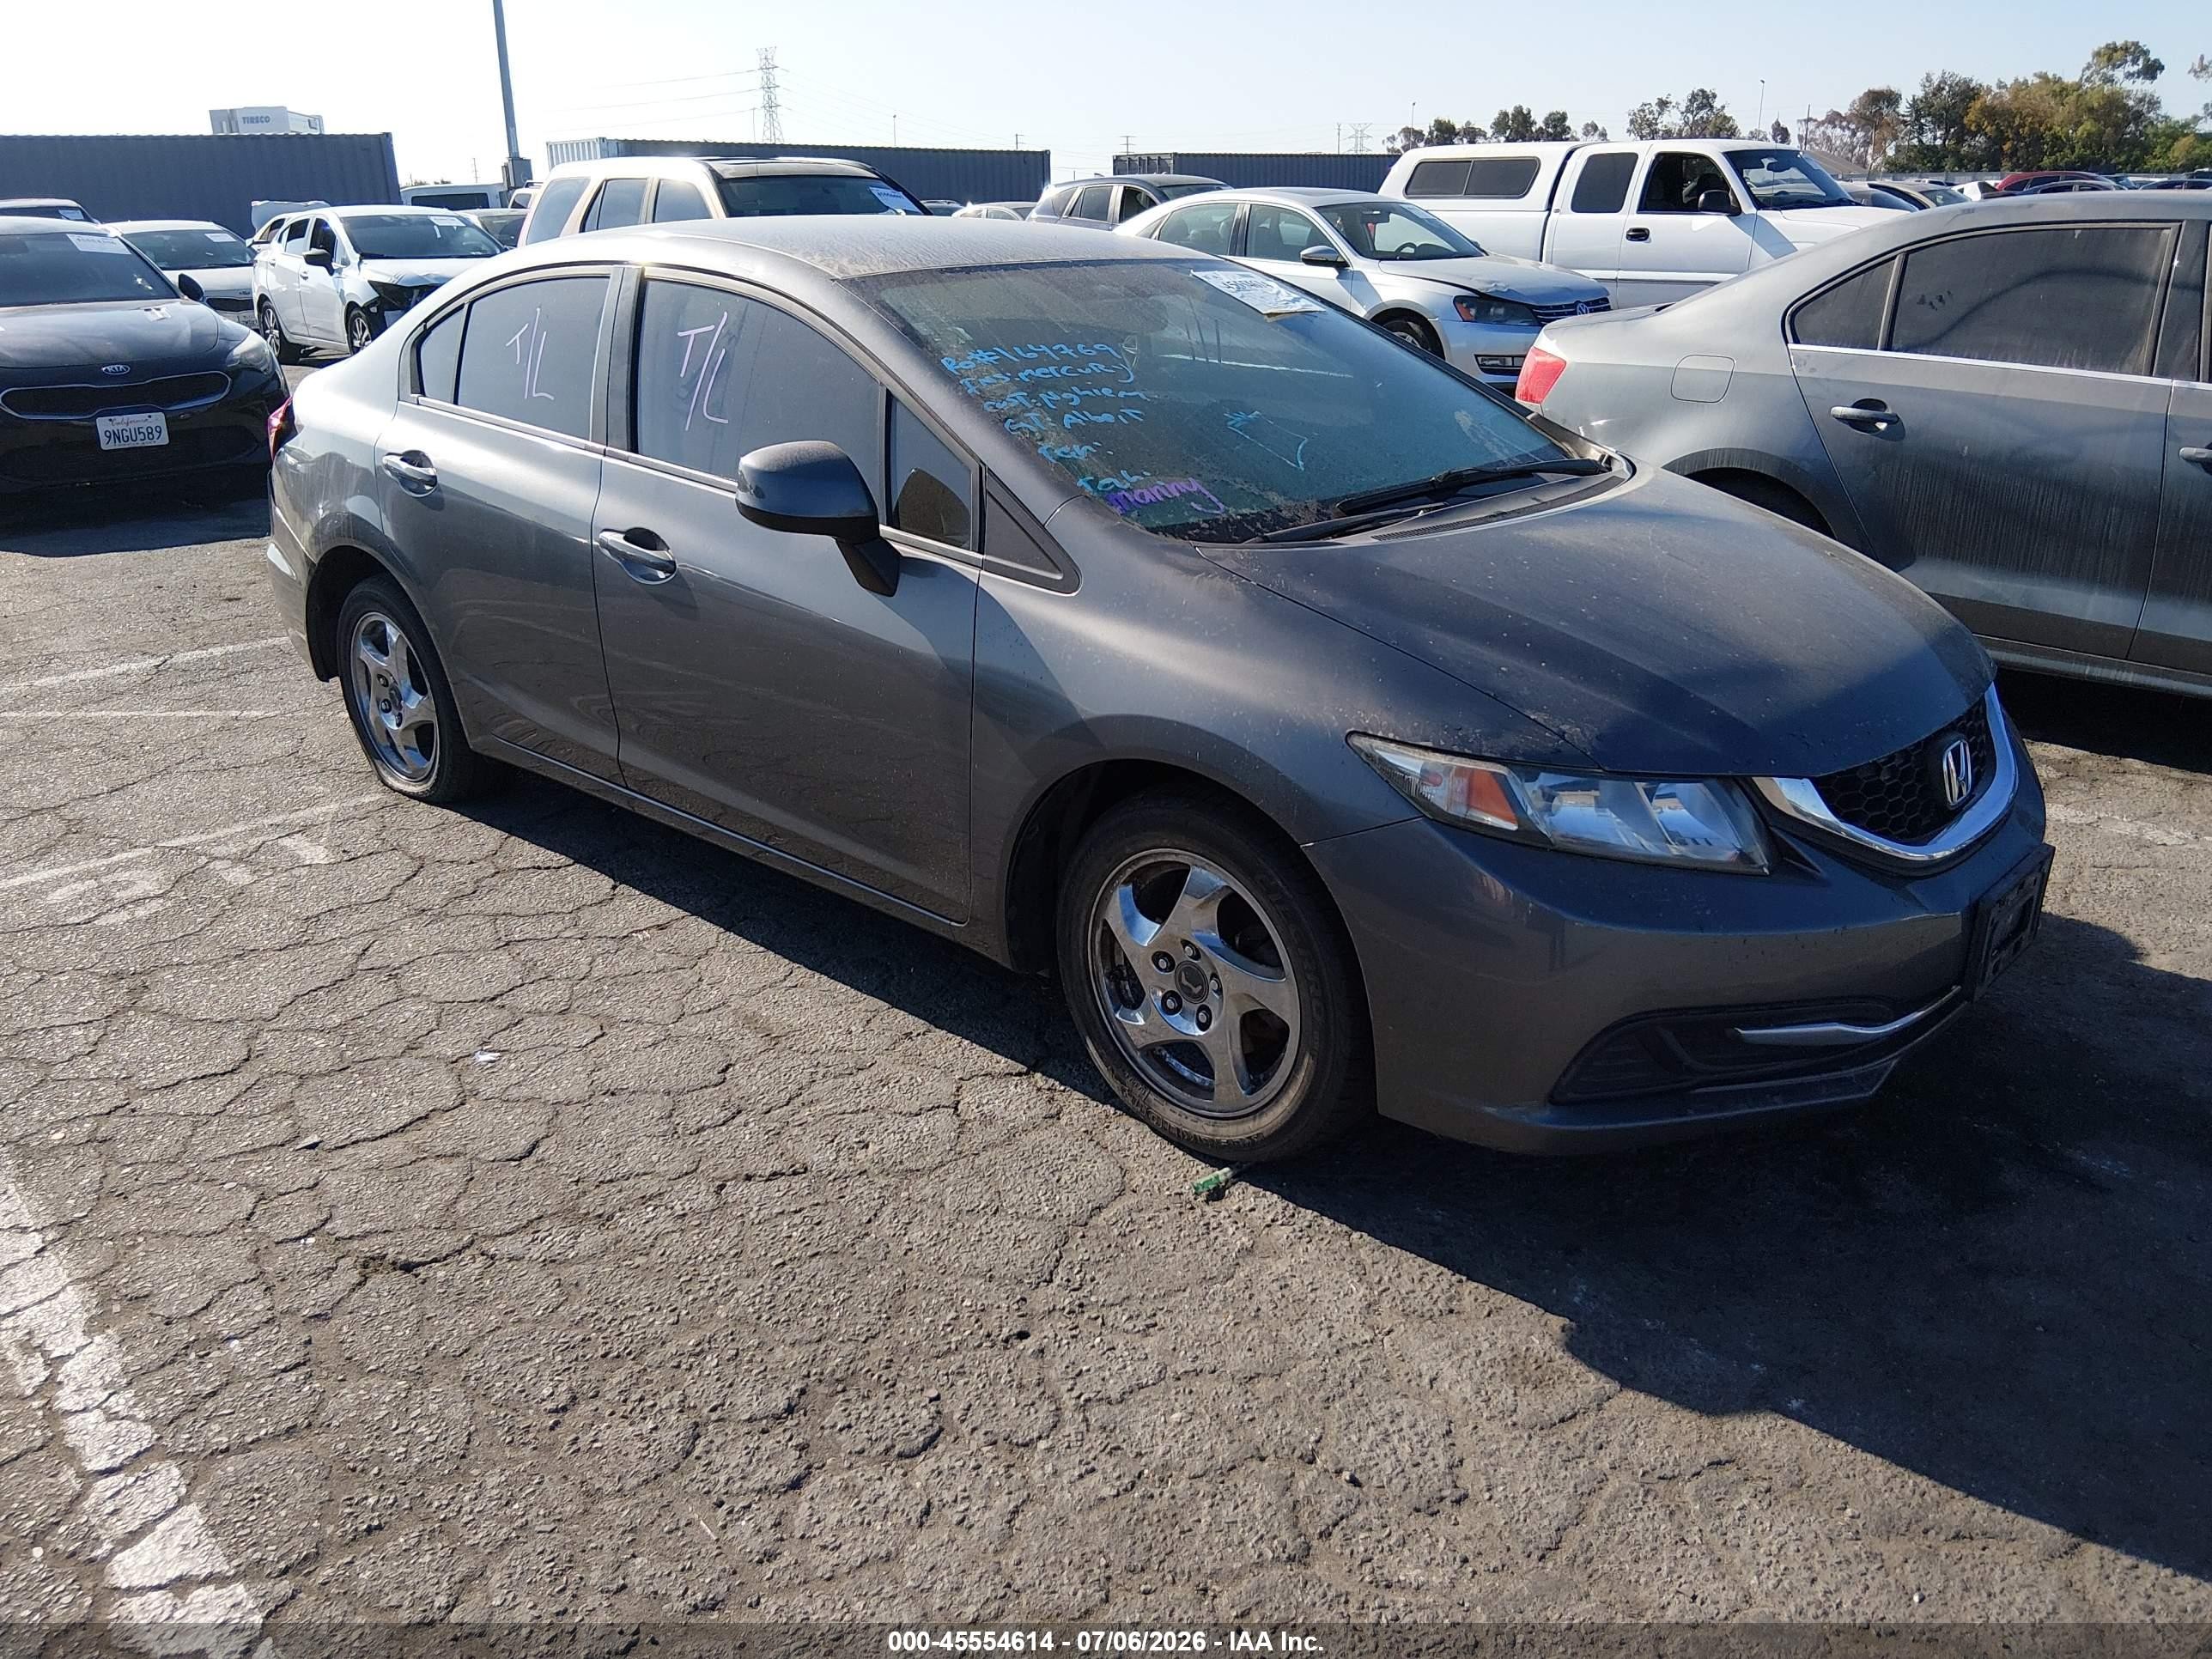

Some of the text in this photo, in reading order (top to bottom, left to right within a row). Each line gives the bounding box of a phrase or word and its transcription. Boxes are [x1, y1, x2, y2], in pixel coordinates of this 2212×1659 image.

[506, 307, 555, 399] T/L
[678, 312, 728, 430] T/L
[104, 425, 162, 445] 9NGU589
